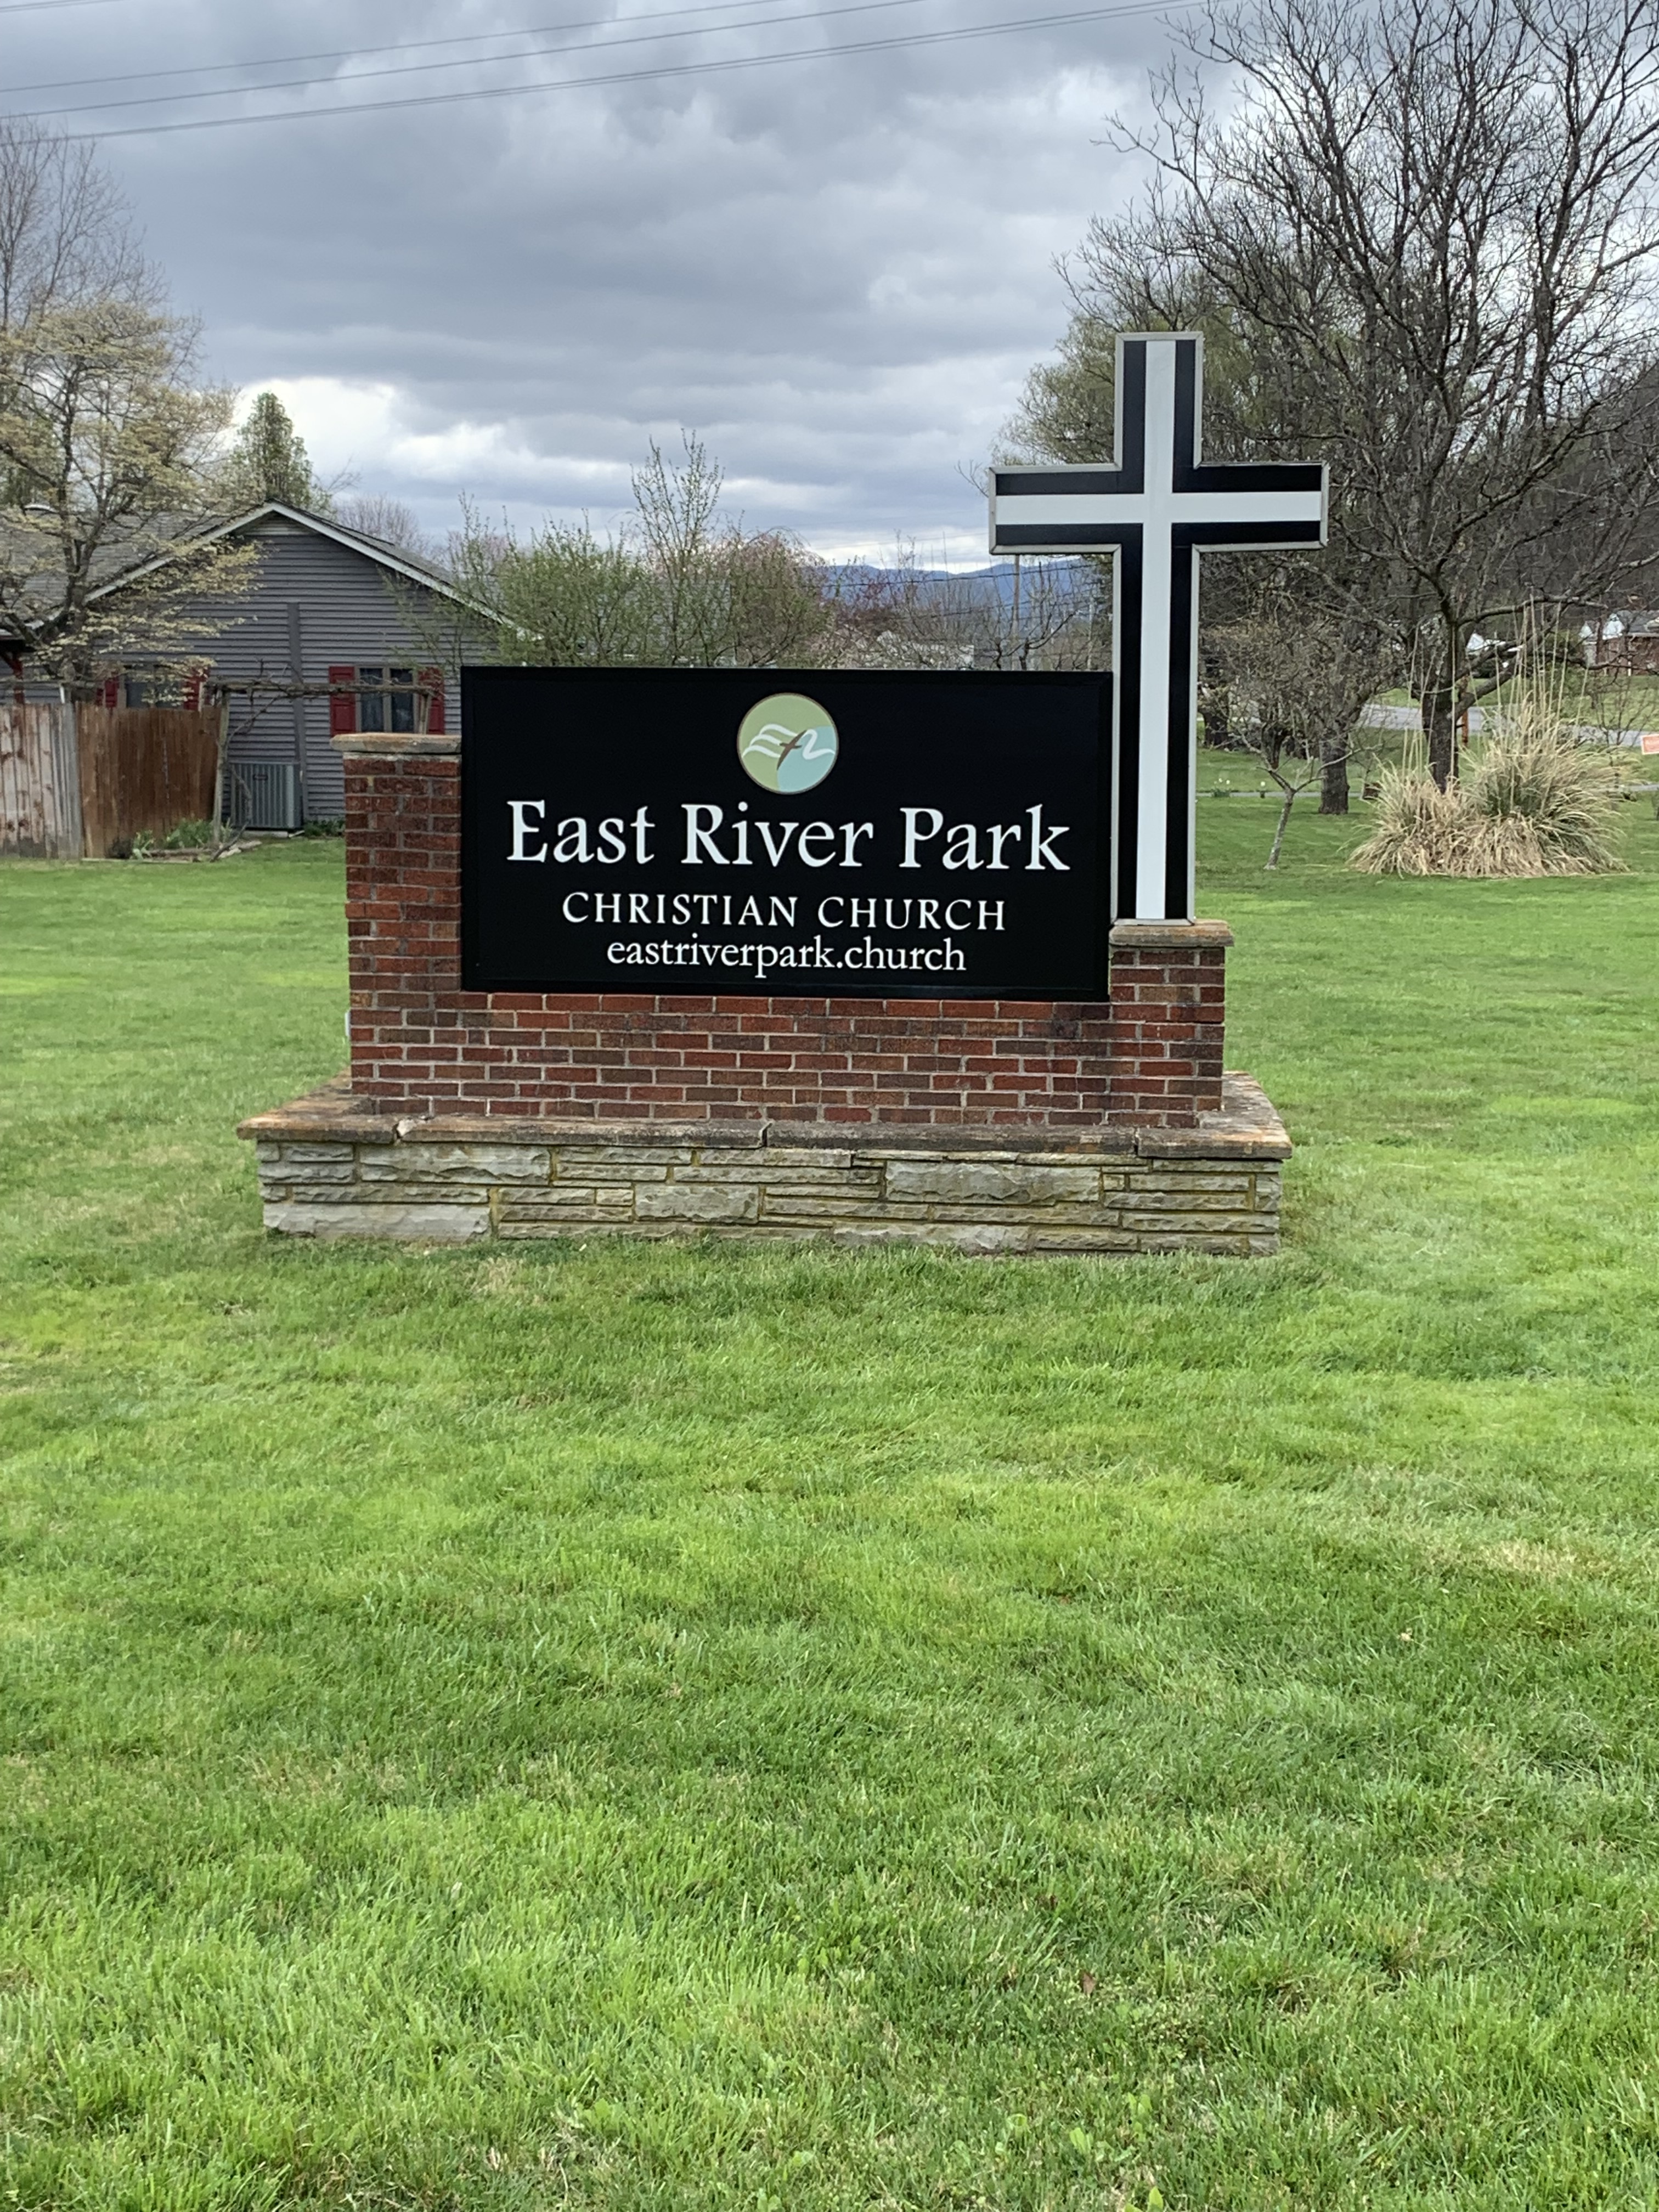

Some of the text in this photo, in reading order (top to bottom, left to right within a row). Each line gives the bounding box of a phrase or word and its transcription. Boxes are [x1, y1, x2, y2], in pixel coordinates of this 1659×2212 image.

[506, 799, 1071, 871] East River Park
[562, 891, 1005, 931] CHRISTIAN CHURCH
[606, 932, 967, 979] eastriverpark.church
